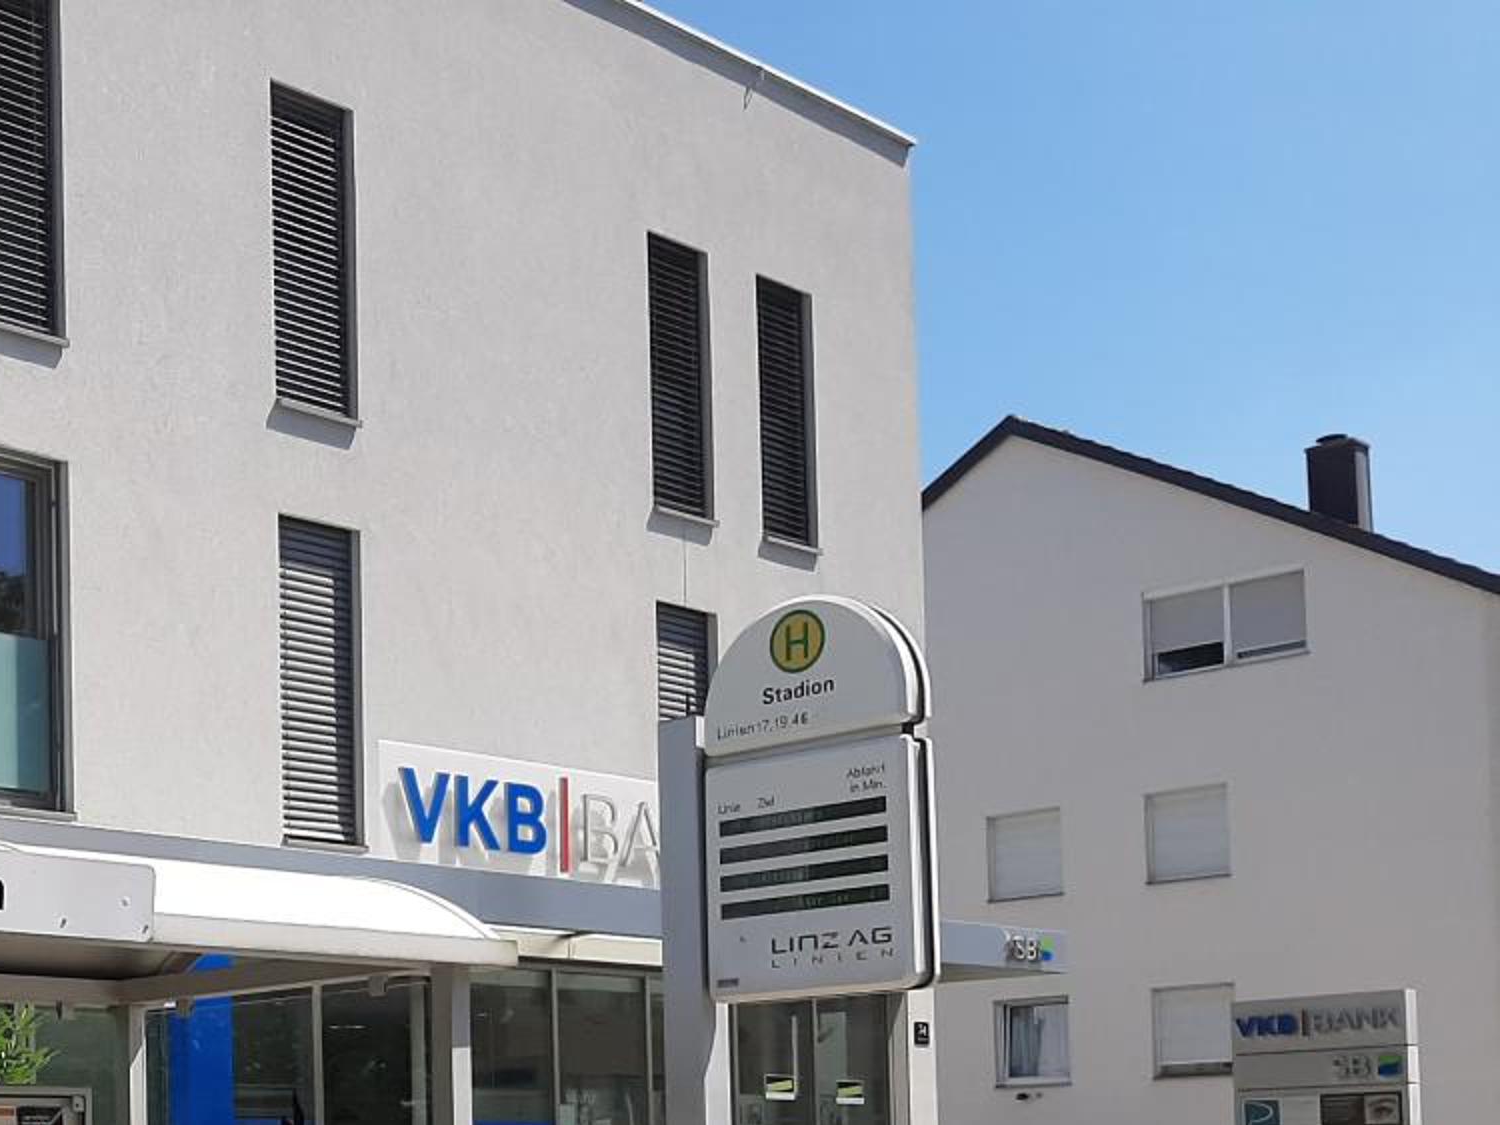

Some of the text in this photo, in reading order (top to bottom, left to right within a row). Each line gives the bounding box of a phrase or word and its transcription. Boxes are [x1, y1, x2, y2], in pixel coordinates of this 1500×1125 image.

[762, 679, 835, 705] Stadion
[717, 724, 754, 740] Linien
[398, 767, 548, 855] VKB
[771, 926, 893, 954] LINZ AG
[771, 947, 894, 969] LINIEN
